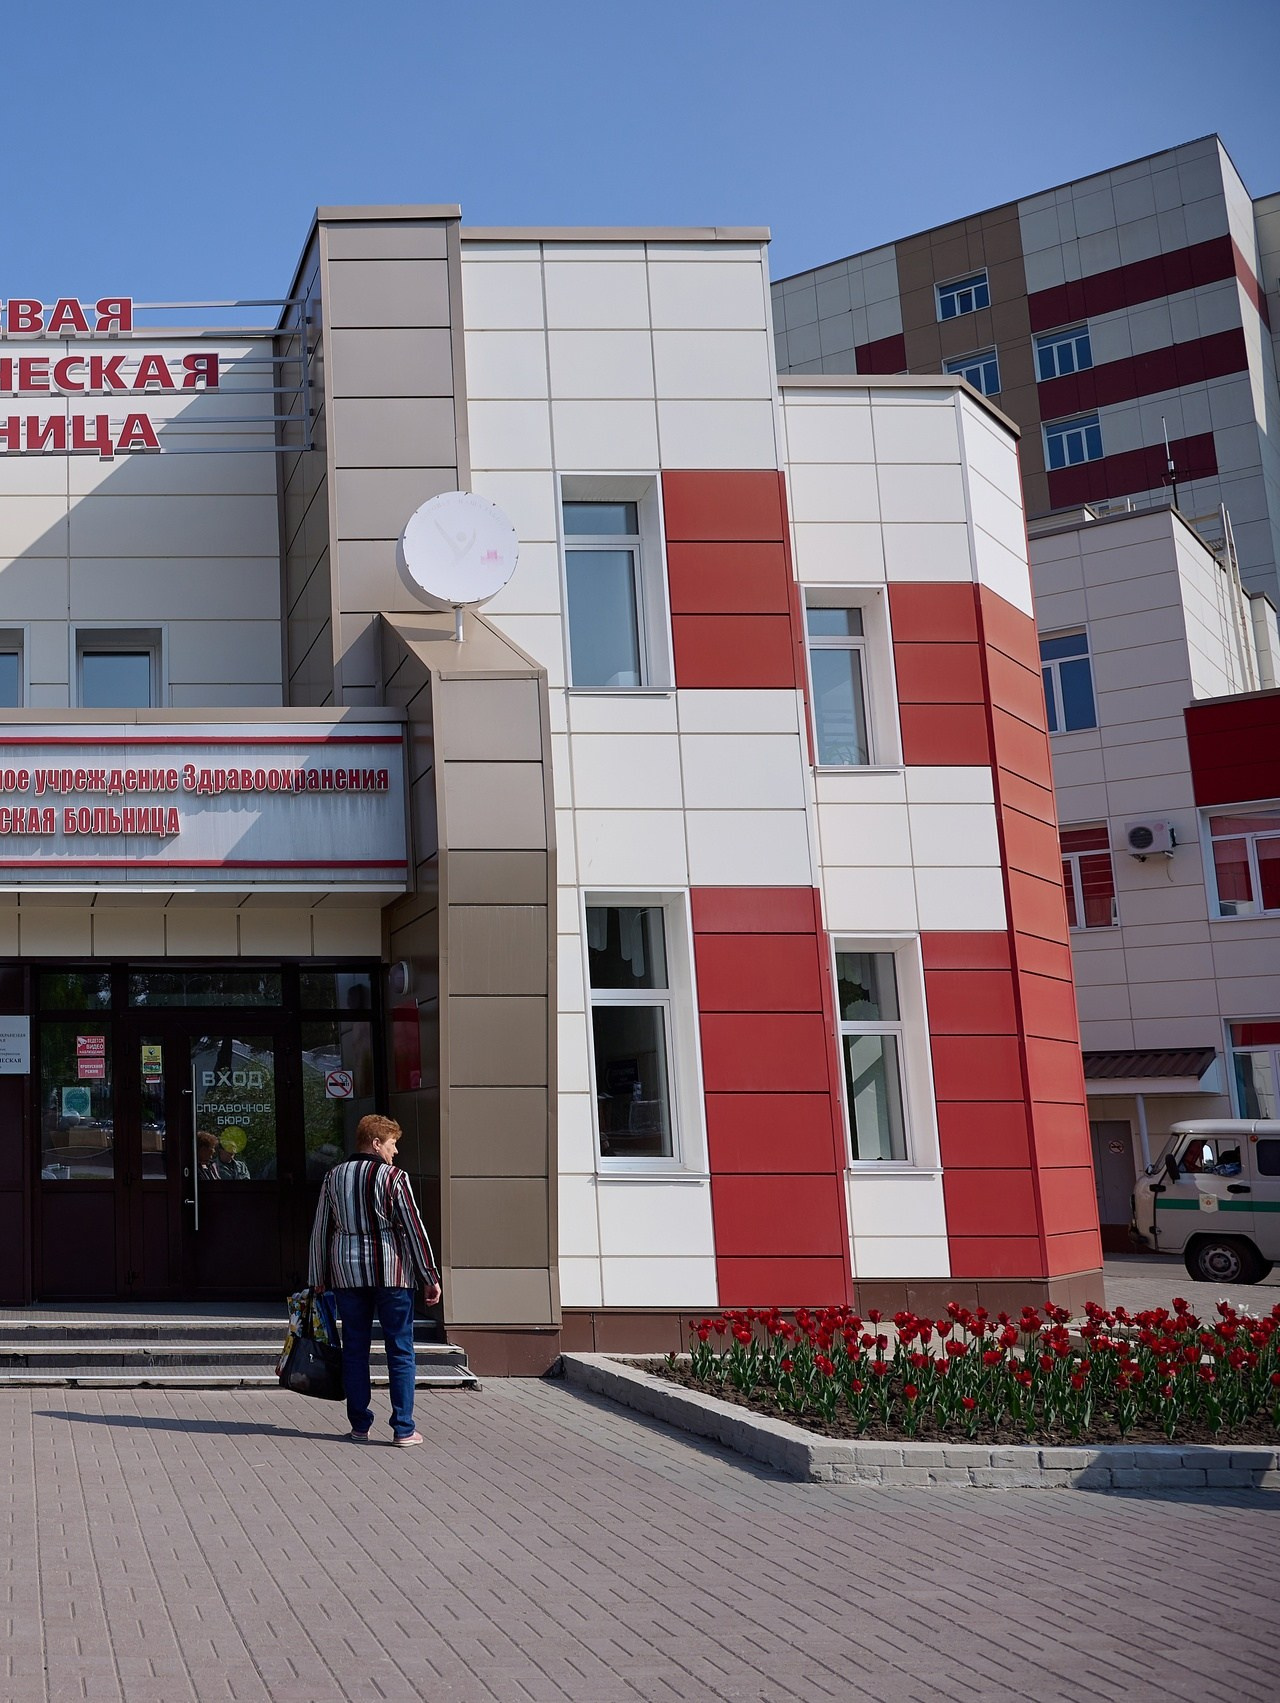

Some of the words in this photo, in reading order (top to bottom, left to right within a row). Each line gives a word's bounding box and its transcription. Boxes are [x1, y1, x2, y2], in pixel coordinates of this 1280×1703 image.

[34, 767, 179, 796] учреждение
[182, 763, 390, 795] Здравоохранения
[62, 806, 181, 838] БОЛЬНИЦА
[201, 1070, 263, 1090] ВХОД
[196, 1103, 272, 1113] СПРАВОЧНОЕ
[217, 1115, 251, 1125] БЮРО
